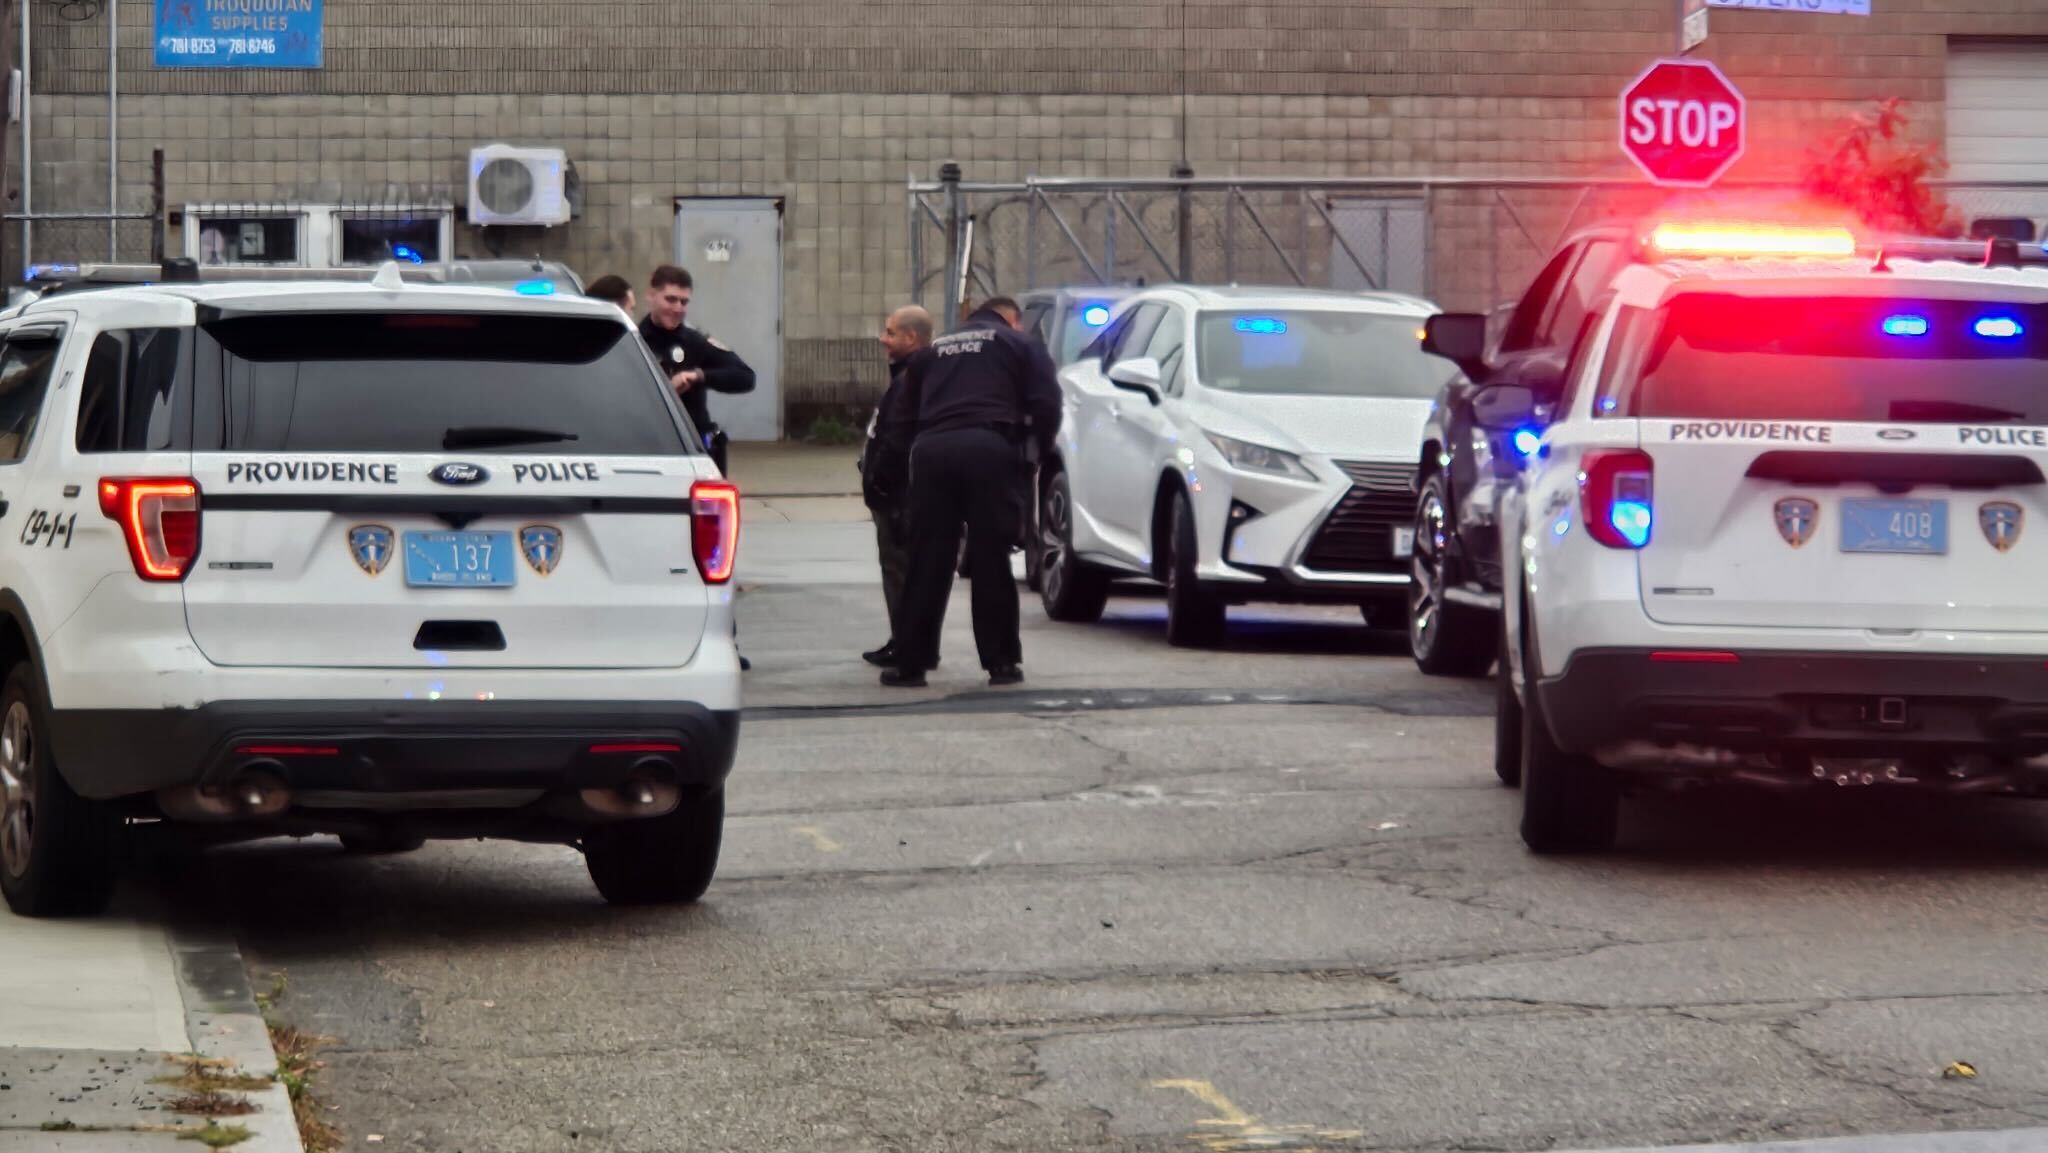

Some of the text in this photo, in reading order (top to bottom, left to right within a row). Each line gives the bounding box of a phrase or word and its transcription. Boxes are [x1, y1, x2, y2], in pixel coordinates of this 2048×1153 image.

[212, 15, 289, 31] SUPPLIES
[1630, 97, 1736, 147] STOP
[937, 341, 983, 357] POLICE
[1670, 421, 2047, 447] PROVIDENCE POLICE
[227, 461, 601, 485] PROVIDENCE POLICE
[1888, 511, 1933, 538] 408
[453, 544, 492, 571] 137
